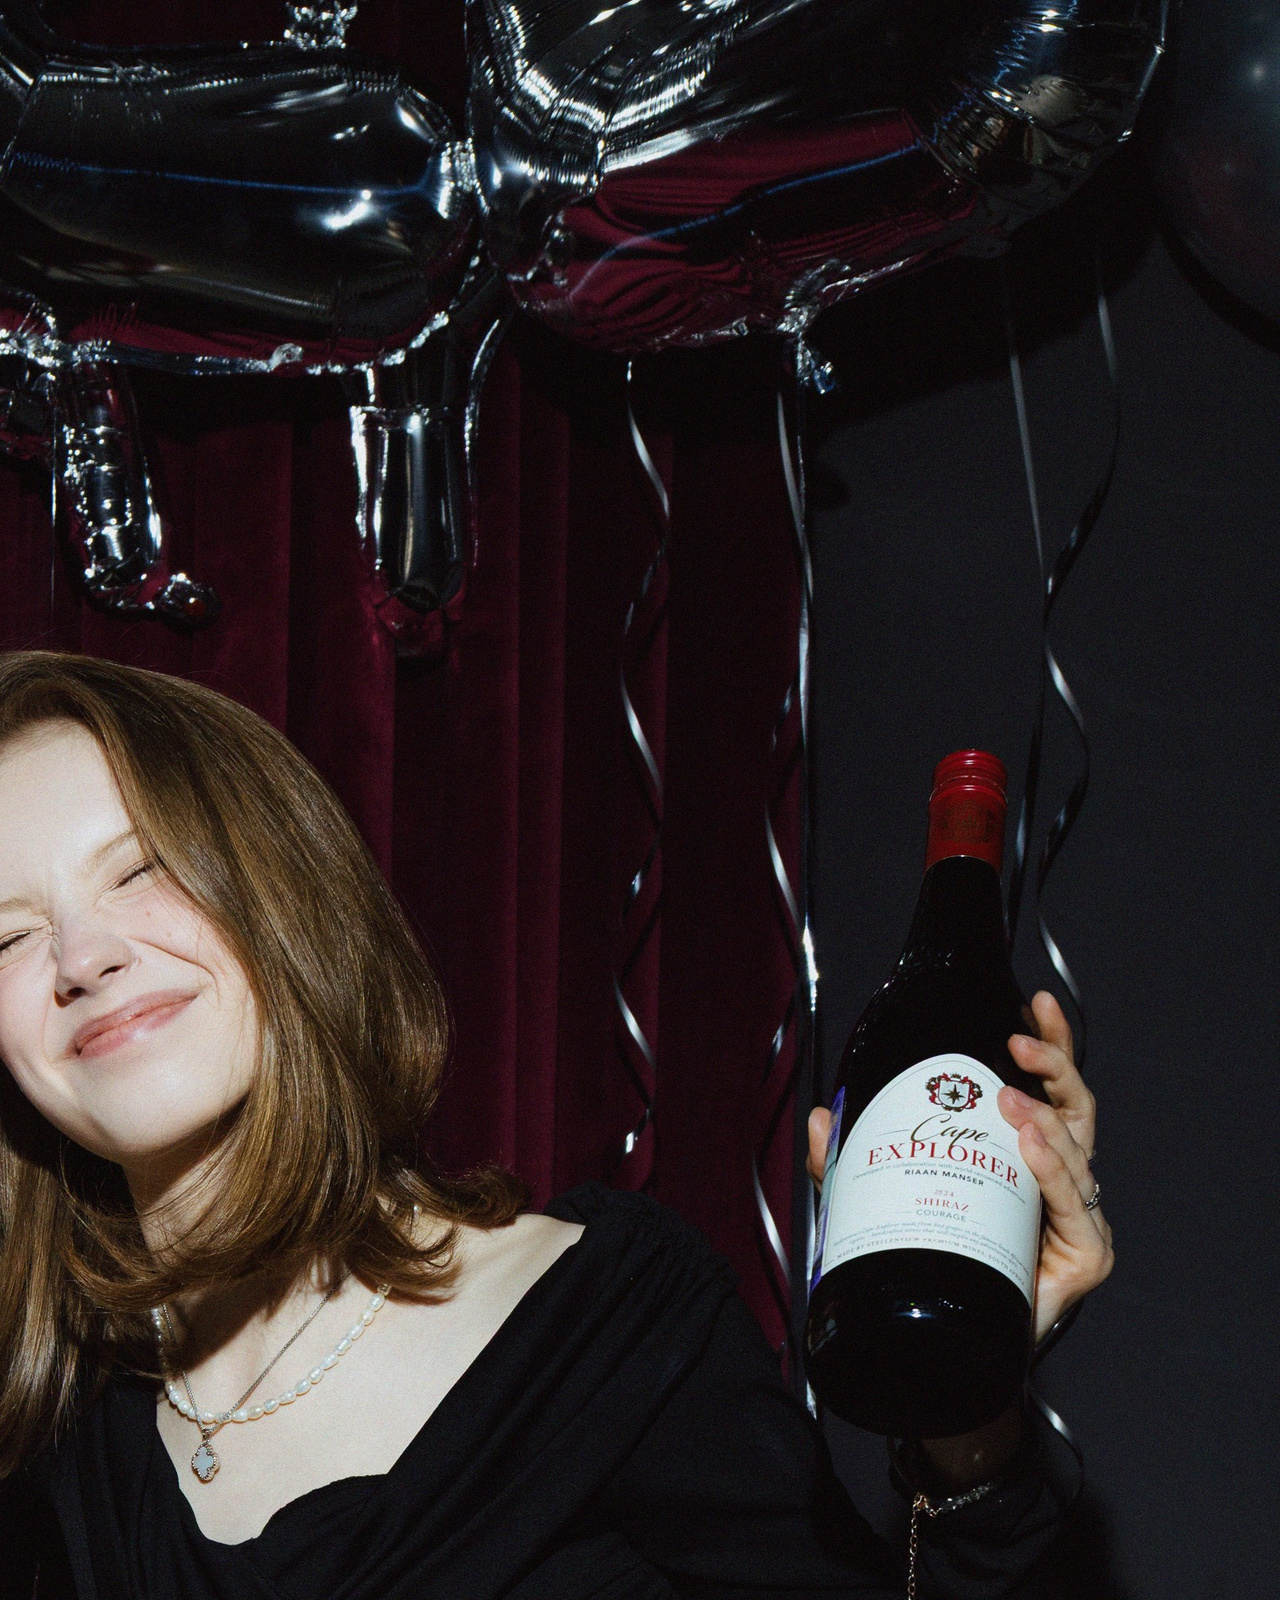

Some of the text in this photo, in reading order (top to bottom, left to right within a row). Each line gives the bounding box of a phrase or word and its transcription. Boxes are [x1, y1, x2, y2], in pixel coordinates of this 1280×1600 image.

[910, 1113, 989, 1149] Cape
[867, 1140, 1019, 1189] EXPLORER
[954, 1165, 973, 1174] world
[942, 1170, 985, 1187] MANSER
[915, 1197, 970, 1213] SHIRAZ
[916, 1209, 967, 1222] COURAGE
[837, 1248, 855, 1258] MADE
[923, 1237, 960, 1247] PREMIUM
